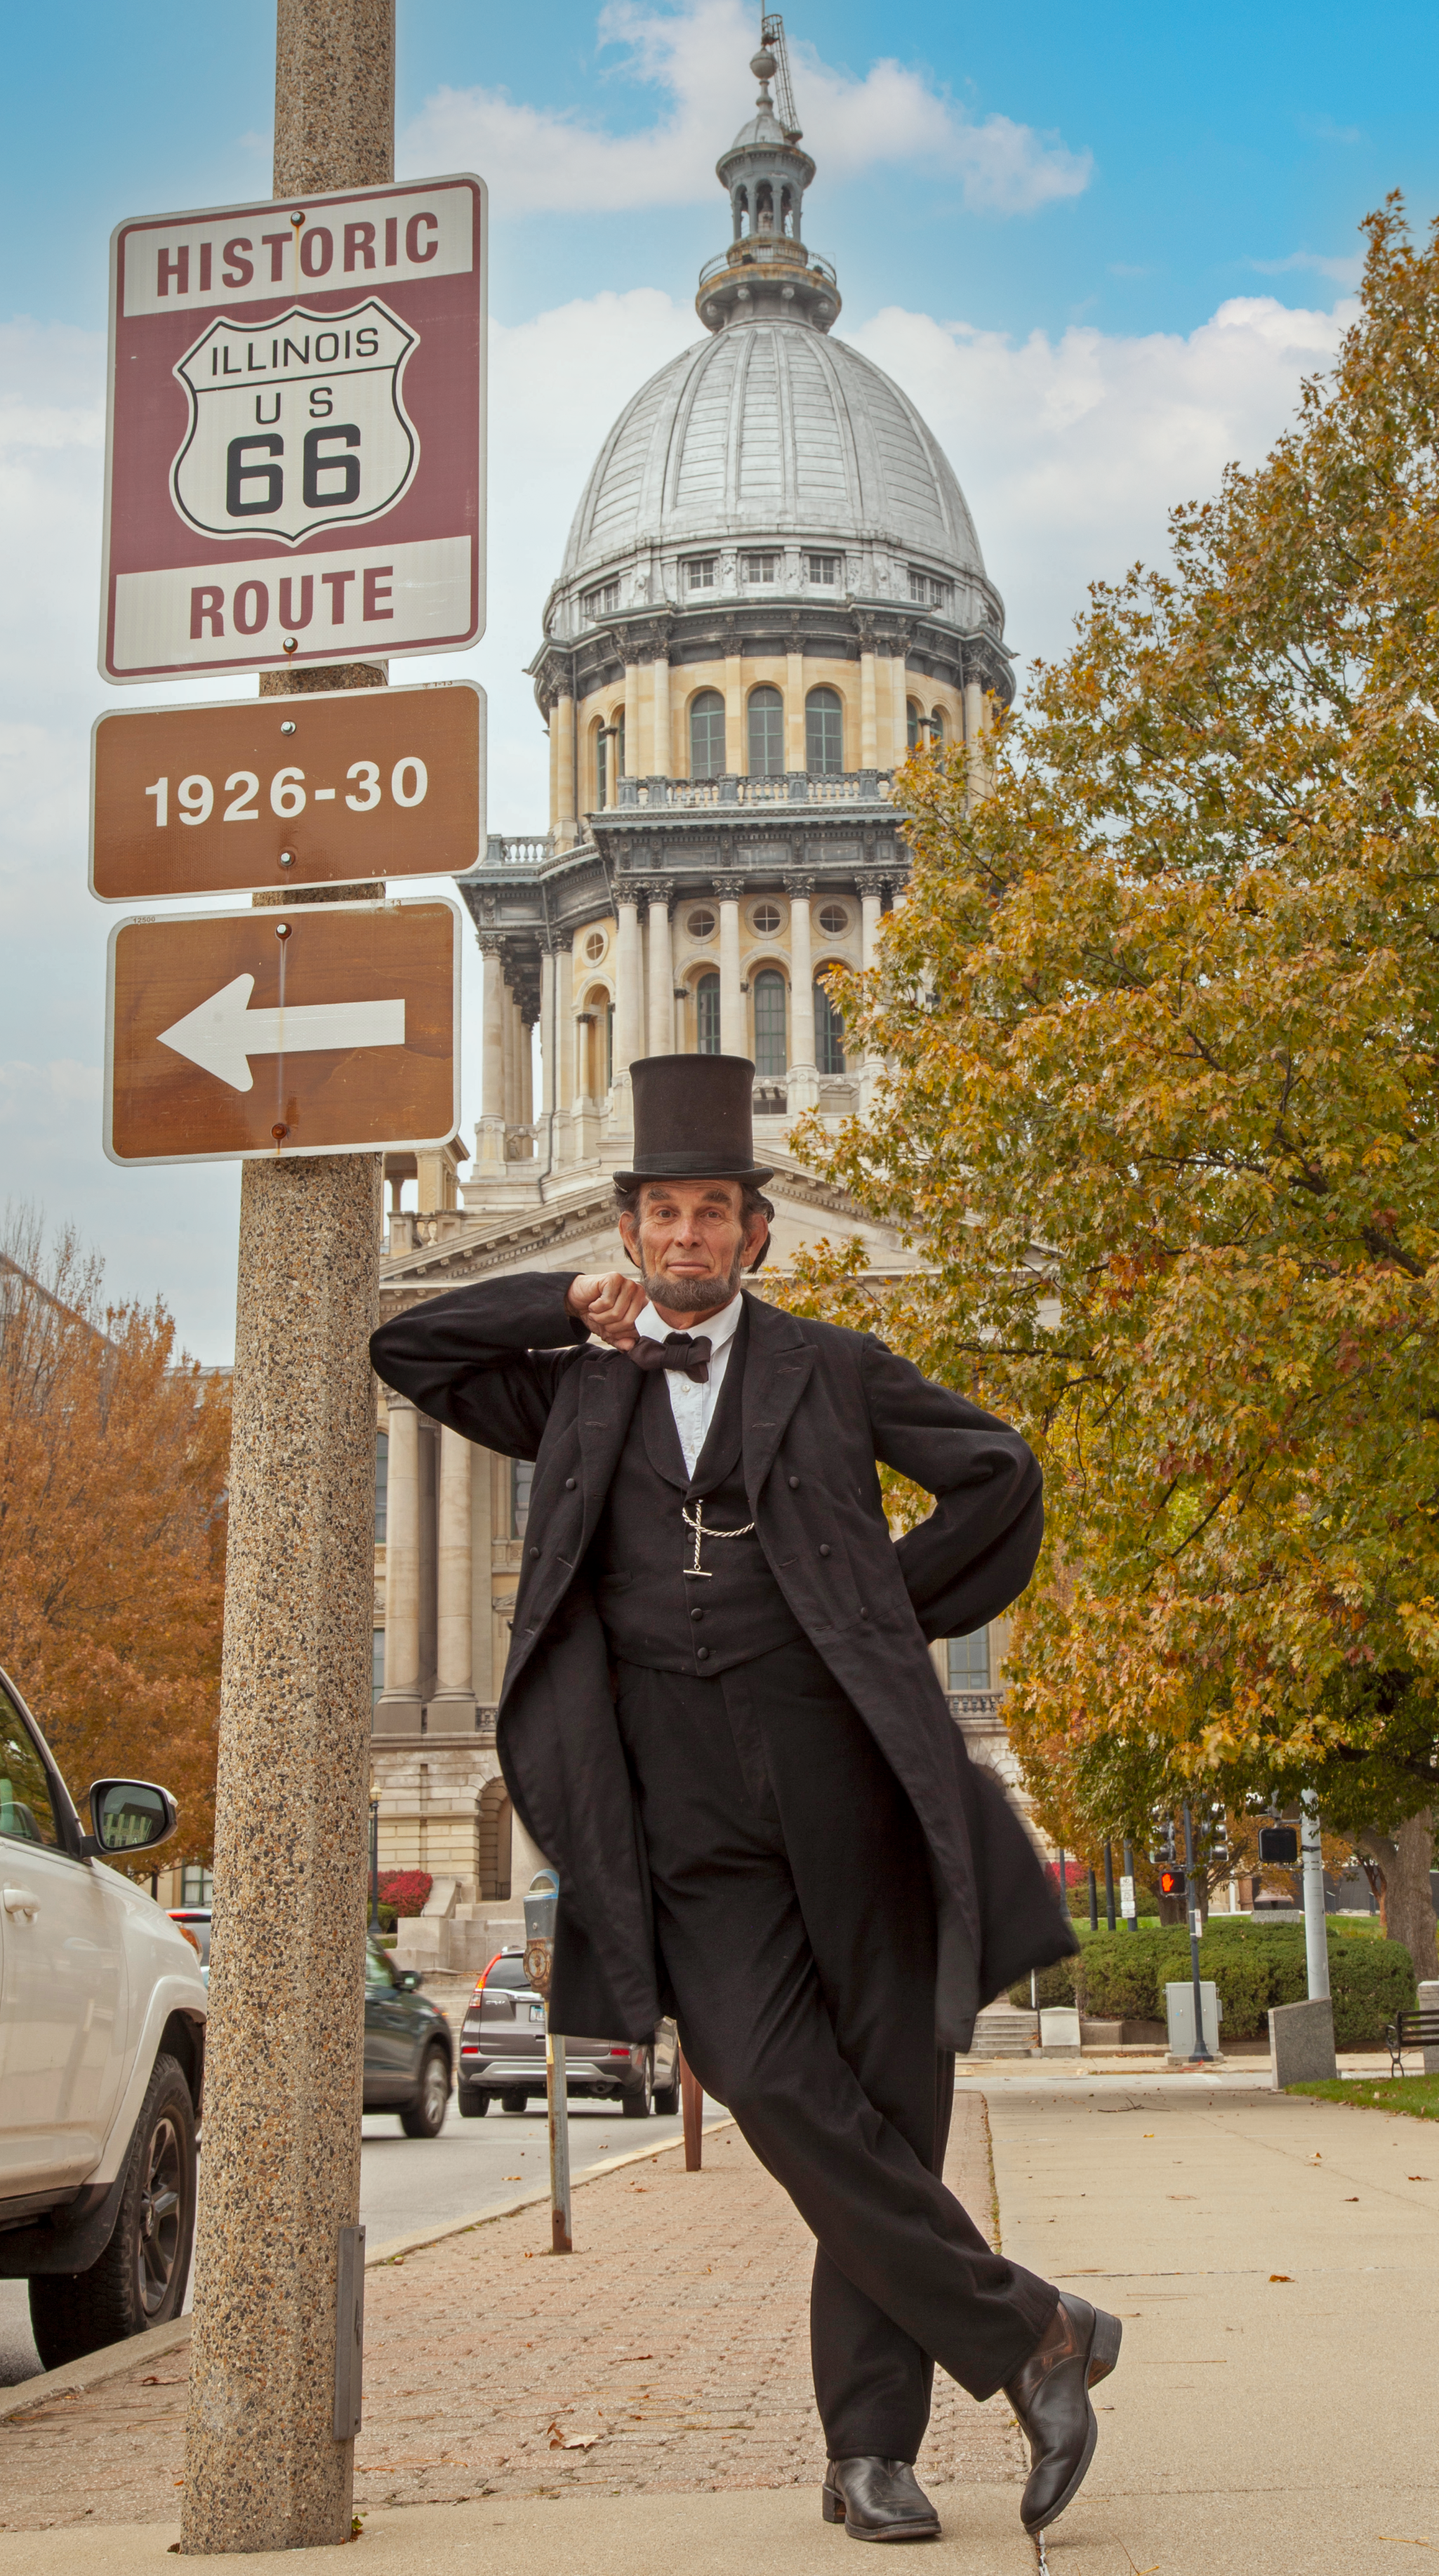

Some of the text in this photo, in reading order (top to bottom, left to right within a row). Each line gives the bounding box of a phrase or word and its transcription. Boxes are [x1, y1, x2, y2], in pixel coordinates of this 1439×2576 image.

[157, 212, 438, 296] HISTORIC
[213, 328, 378, 376] ILLINOIS
[226, 424, 360, 517] 66
[190, 566, 393, 639] ROUTE
[146, 757, 427, 826] 1926-30
